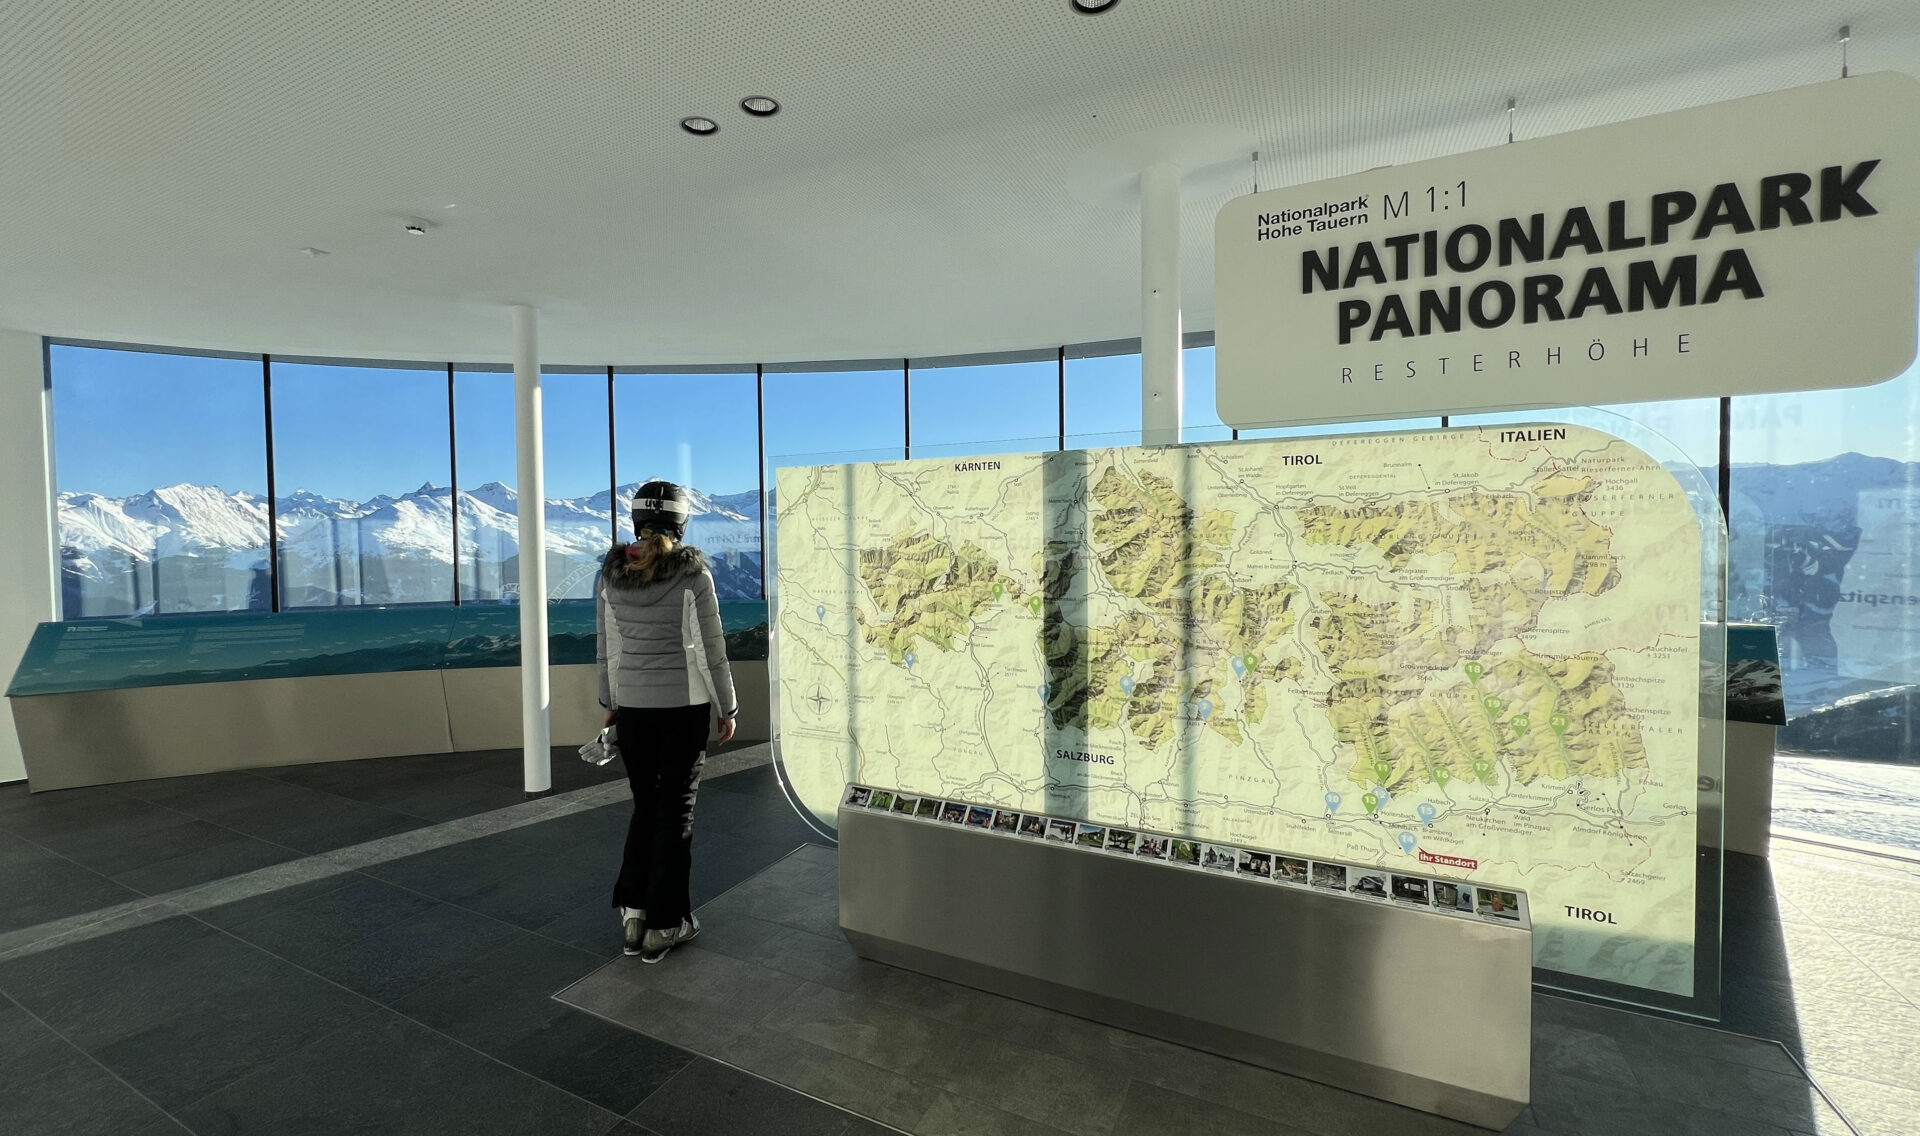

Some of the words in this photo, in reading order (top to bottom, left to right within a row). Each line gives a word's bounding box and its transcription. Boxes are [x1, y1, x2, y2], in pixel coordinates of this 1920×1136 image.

[1384, 191, 1409, 220] M
[1426, 180, 1467, 212] 1:1
[1257, 196, 1369, 227] Nationalpark
[1257, 223, 1303, 241] Hohe
[1307, 212, 1369, 233] Tauern
[1302, 159, 1882, 294] NATIONALPARK
[1338, 248, 1765, 345] PANORAMA
[1342, 333, 1691, 384] RESTERHÖHE
[1332, 437, 1405, 446] DEFEREGGEN
[1413, 433, 1465, 442] GEBIRGE
[1500, 428, 1566, 443] ITALIEN
[1281, 454, 1323, 466] TIROL
[1581, 456, 1625, 465] Naturpark
[954, 461, 1001, 473] KÄRNTEN
[1605, 478, 1638, 486] Hochgall
[1468, 665, 1481, 674] 18
[1487, 700, 1501, 709] 19
[1512, 717, 1528, 726] 20
[1552, 717, 1566, 726] 21
[1056, 749, 1115, 766] SALZBURG
[1377, 763, 1389, 772] 11
[1475, 763, 1489, 771] 17
[1228, 774, 1274, 785] PINZGAU
[1436, 769, 1449, 779] 16
[1364, 796, 1377, 805] 13
[1421, 805, 1433, 815] 15
[1420, 852, 1433, 863] Ihr
[1434, 854, 1476, 869] Standort
[1564, 905, 1618, 925] TIROL
